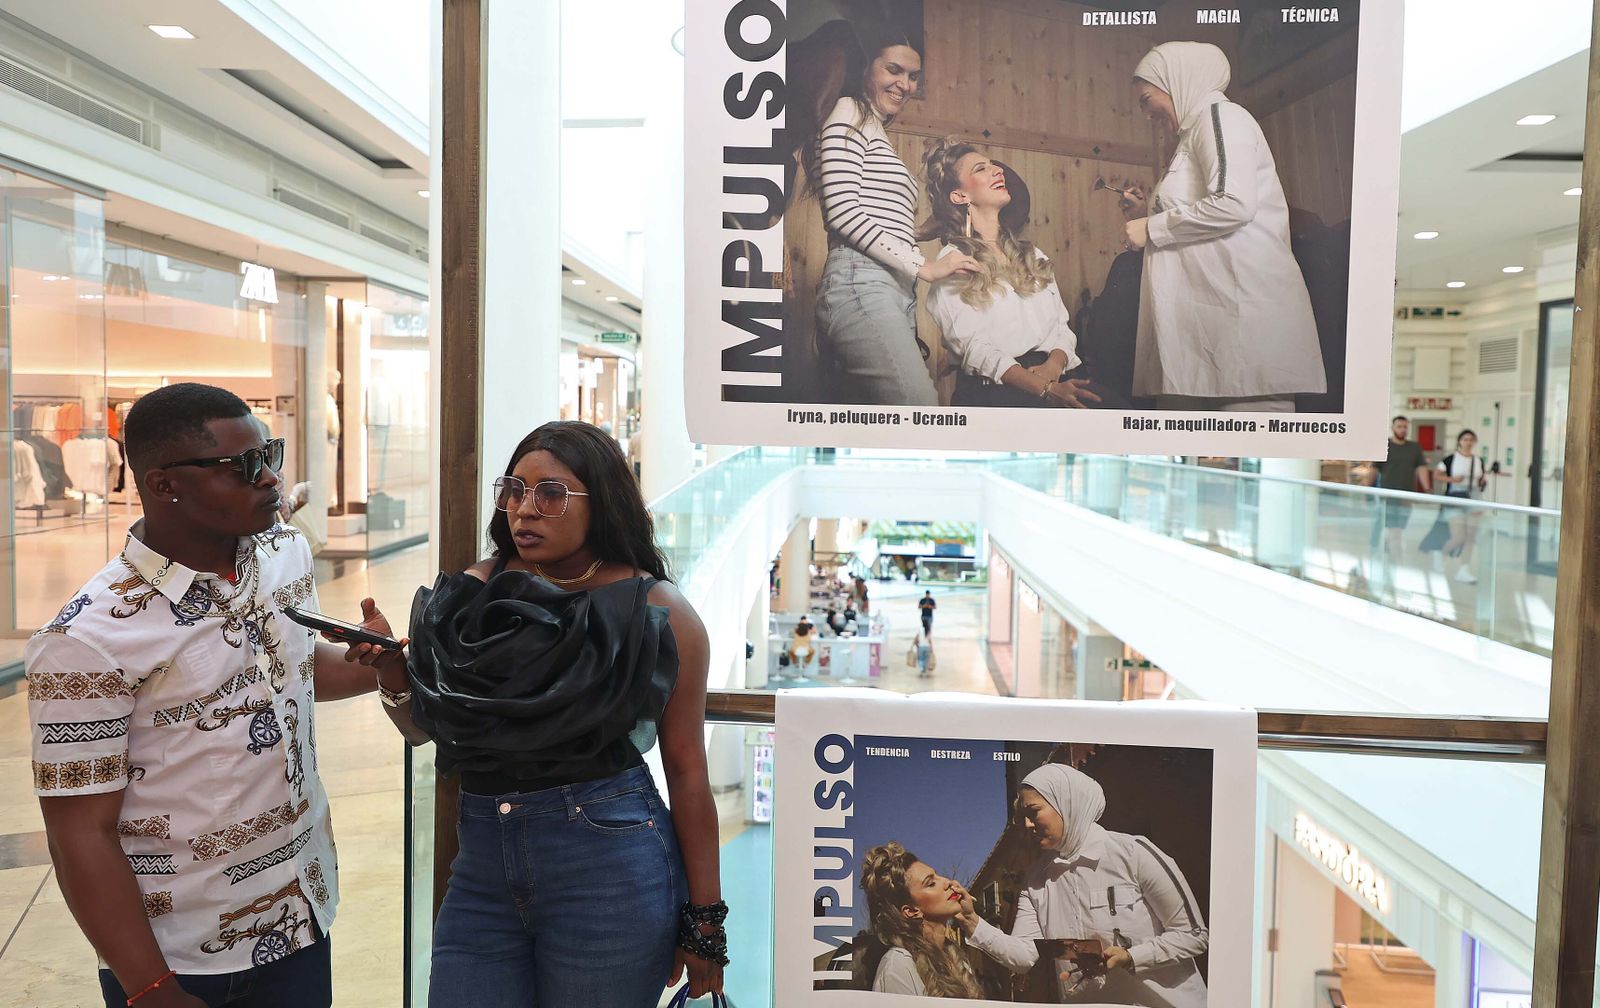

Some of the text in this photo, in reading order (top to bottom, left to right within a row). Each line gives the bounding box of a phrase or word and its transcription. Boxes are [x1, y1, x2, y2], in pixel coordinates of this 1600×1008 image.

[1082, 11, 1157, 26] DETALLISTA
[1196, 9, 1241, 24] MAGIA
[1281, 5, 1340, 23] TÉCNICA
[721, 0, 787, 401] IMPULSO
[787, 409, 826, 425] Iryna,
[830, 410, 900, 425] peluquera
[912, 411, 967, 426] Ucrania
[1123, 416, 1161, 431] Hajar,
[1164, 417, 1257, 432] maquilladora
[1268, 419, 1346, 434] Marruecos
[865, 746, 910, 758] TENDENCIA
[930, 749, 971, 760] DESTREZA
[993, 751, 1021, 762] ESTILO
[813, 733, 854, 992] IMPULSO
